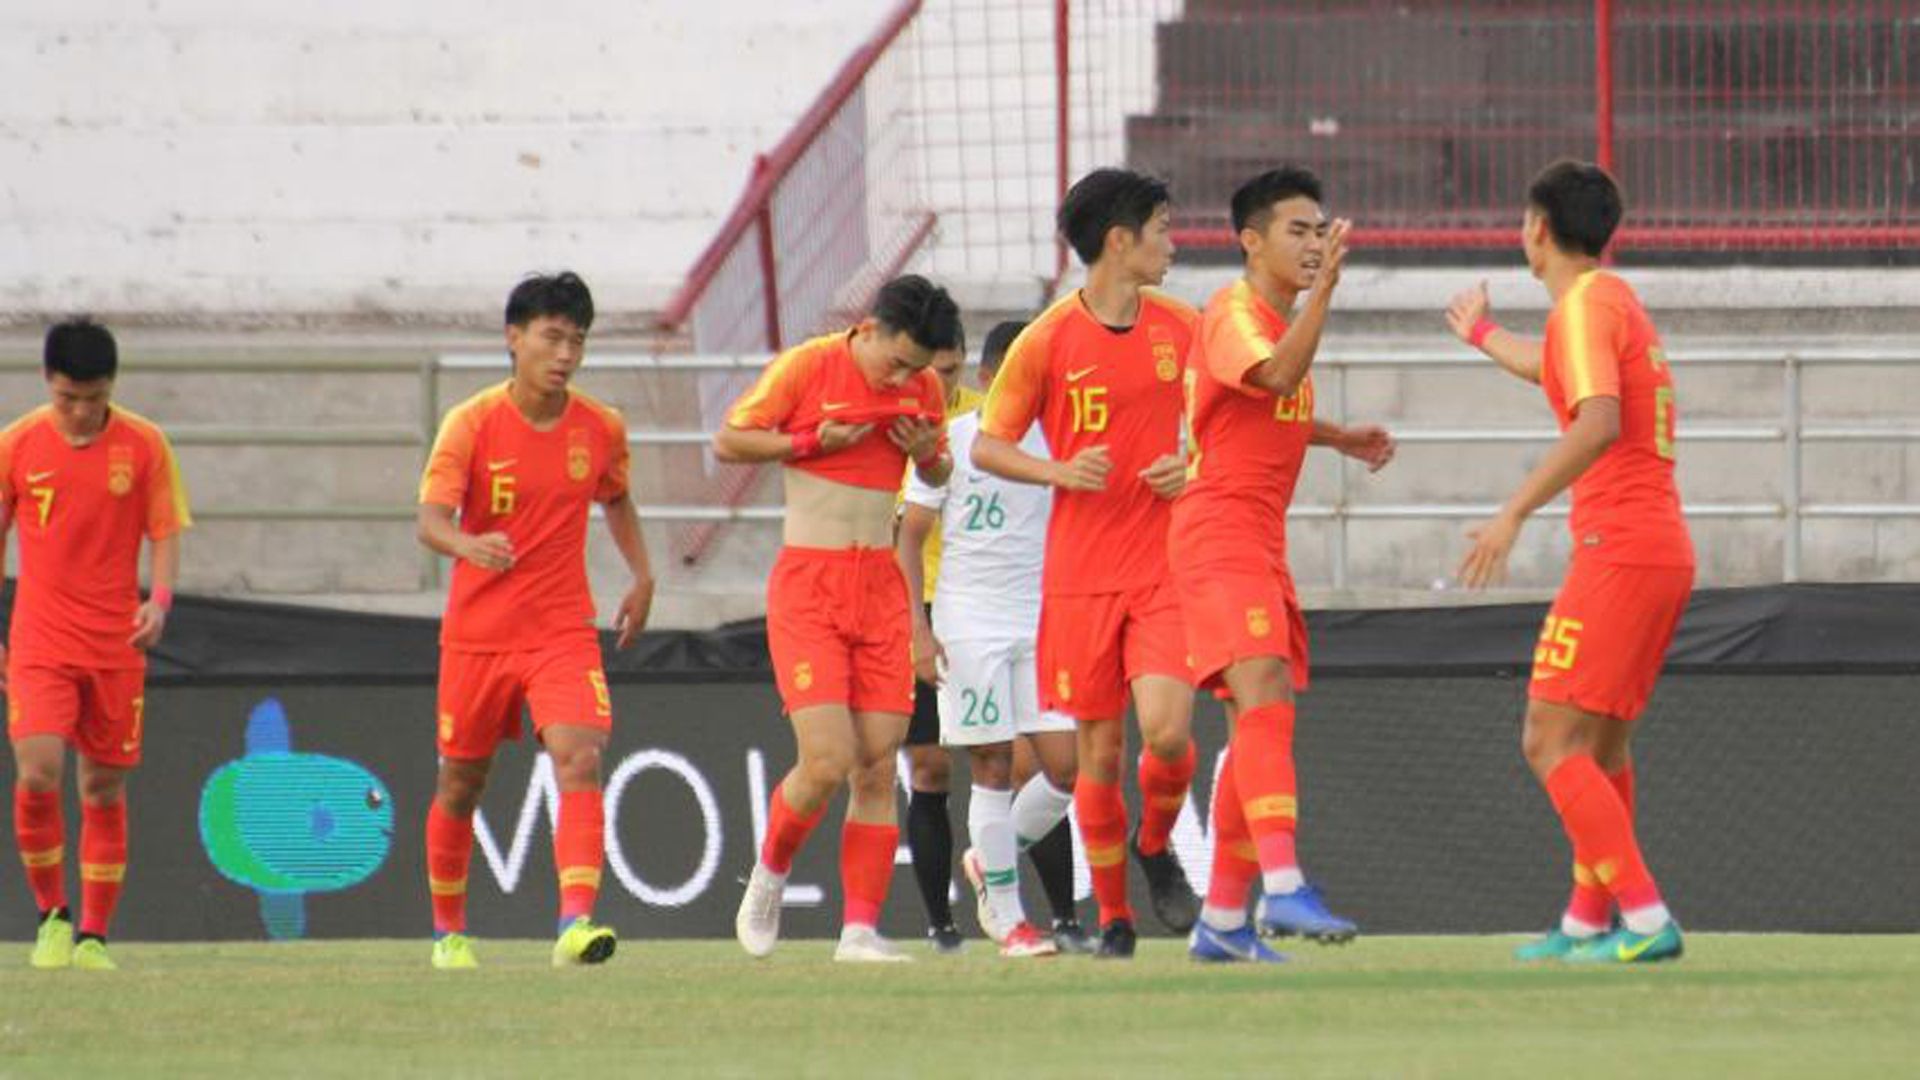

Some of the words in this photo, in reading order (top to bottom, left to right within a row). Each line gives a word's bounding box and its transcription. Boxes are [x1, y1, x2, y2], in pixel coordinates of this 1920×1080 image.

[1069, 387, 1108, 433] 16
[31, 488, 54, 527] 7
[491, 476, 515, 514] 6
[964, 492, 1005, 531] 26
[961, 689, 1000, 726] 26
